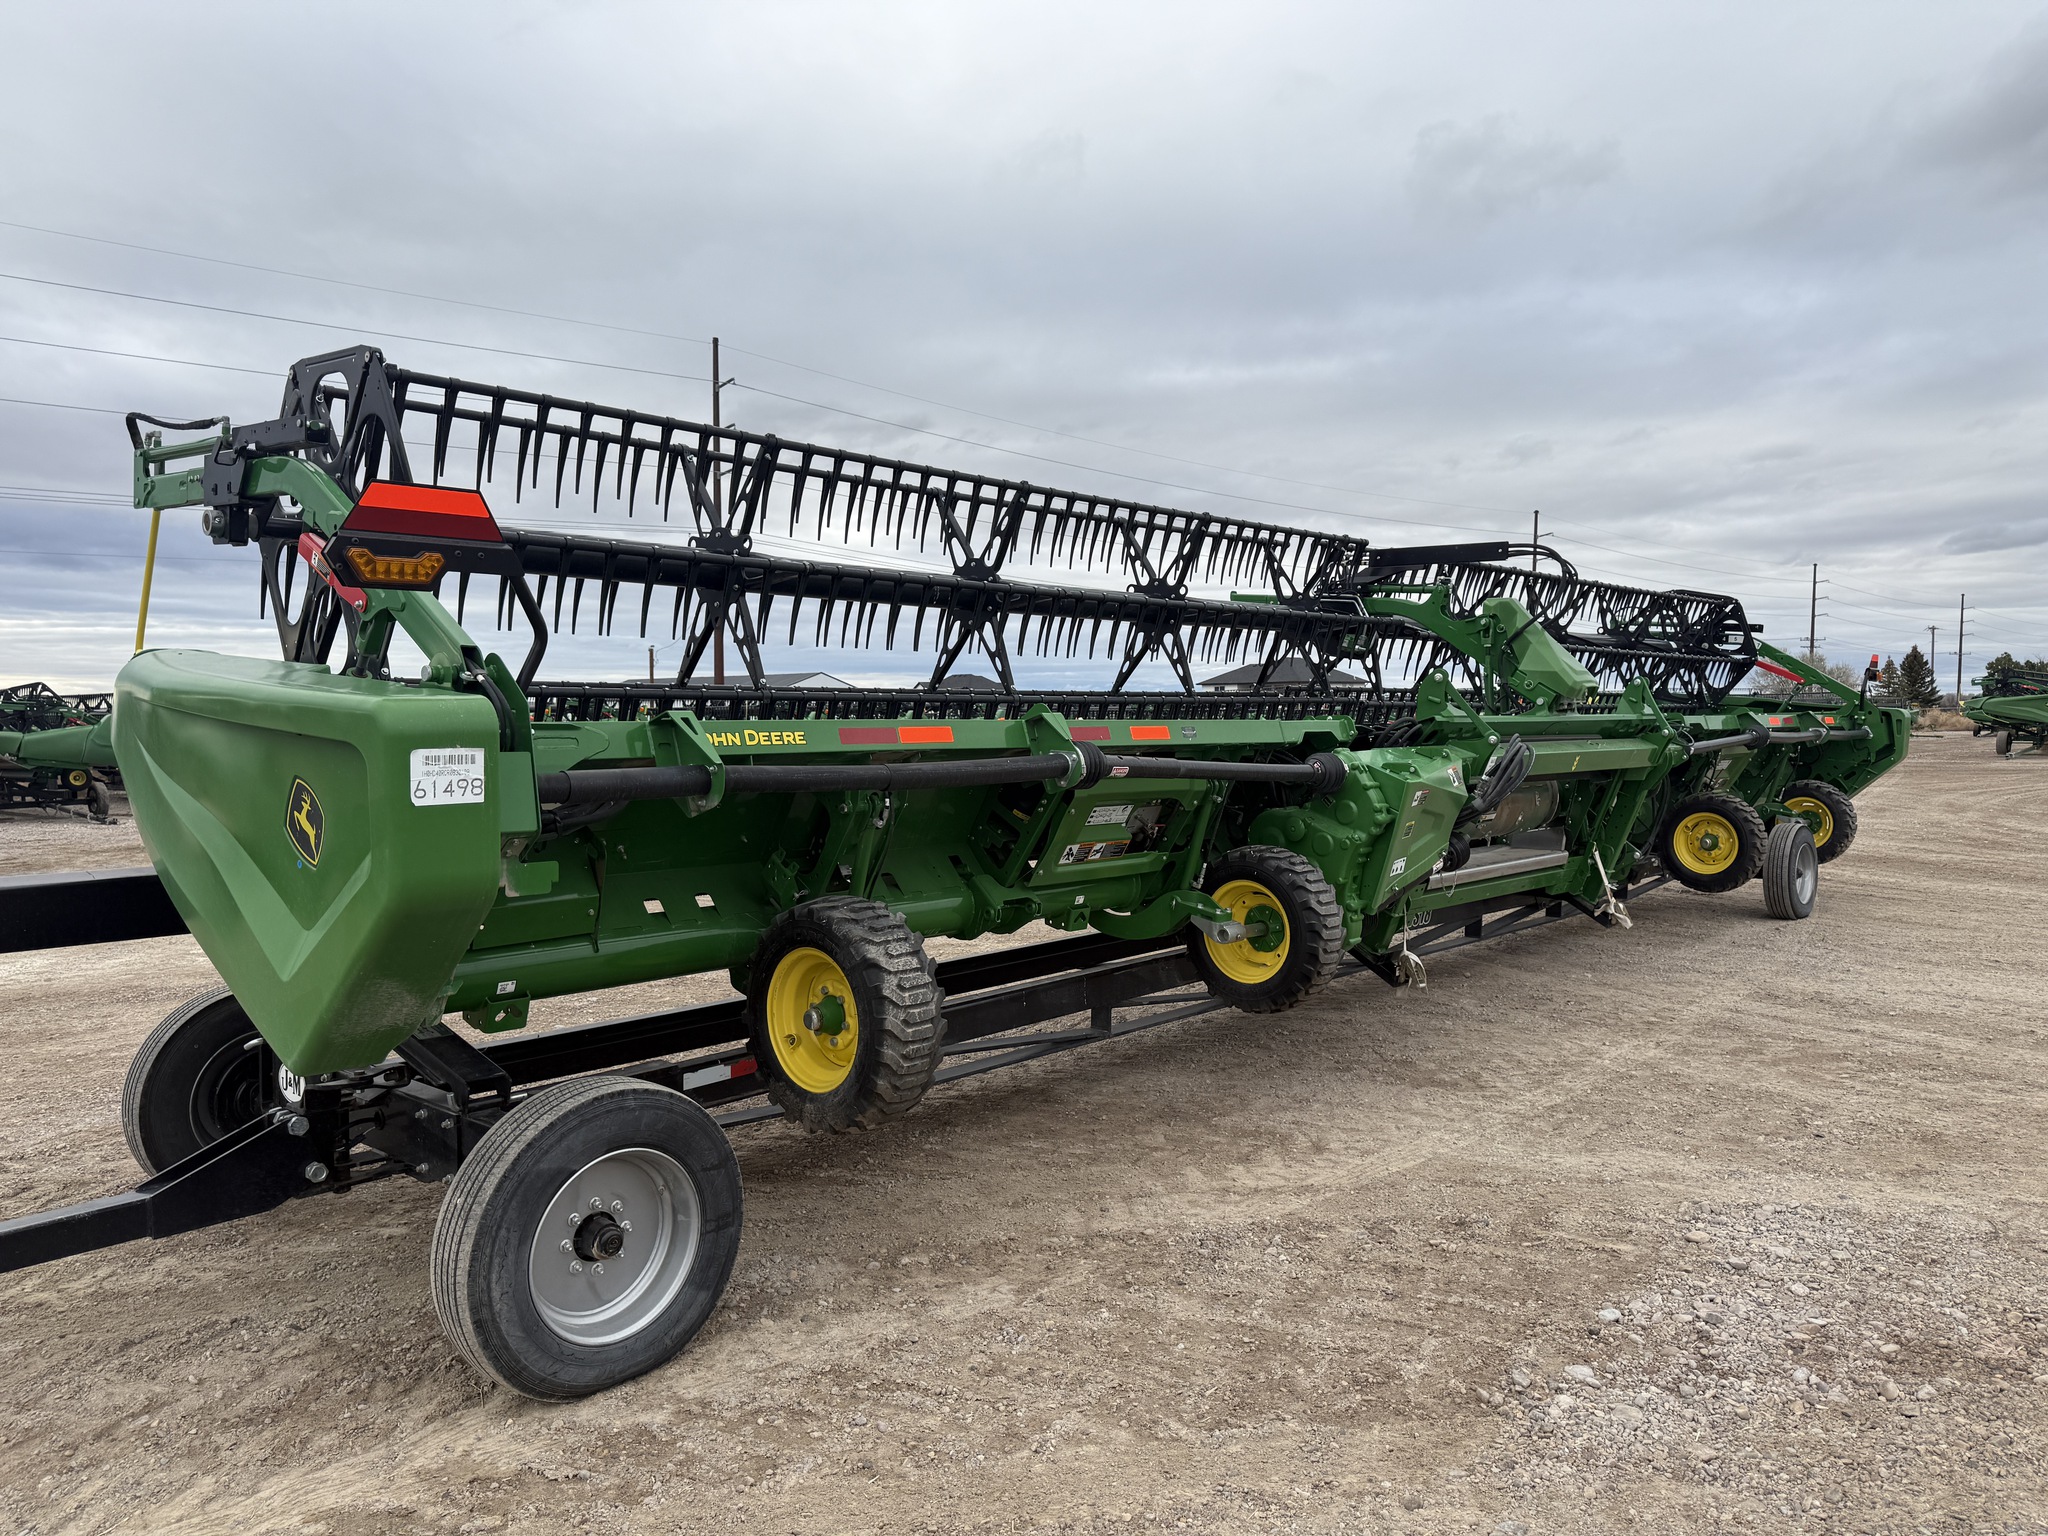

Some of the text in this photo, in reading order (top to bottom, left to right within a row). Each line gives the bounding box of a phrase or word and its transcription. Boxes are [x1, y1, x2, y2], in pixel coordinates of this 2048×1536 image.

[704, 729, 807, 747] HN DEERE
[413, 778, 483, 799] 61498
